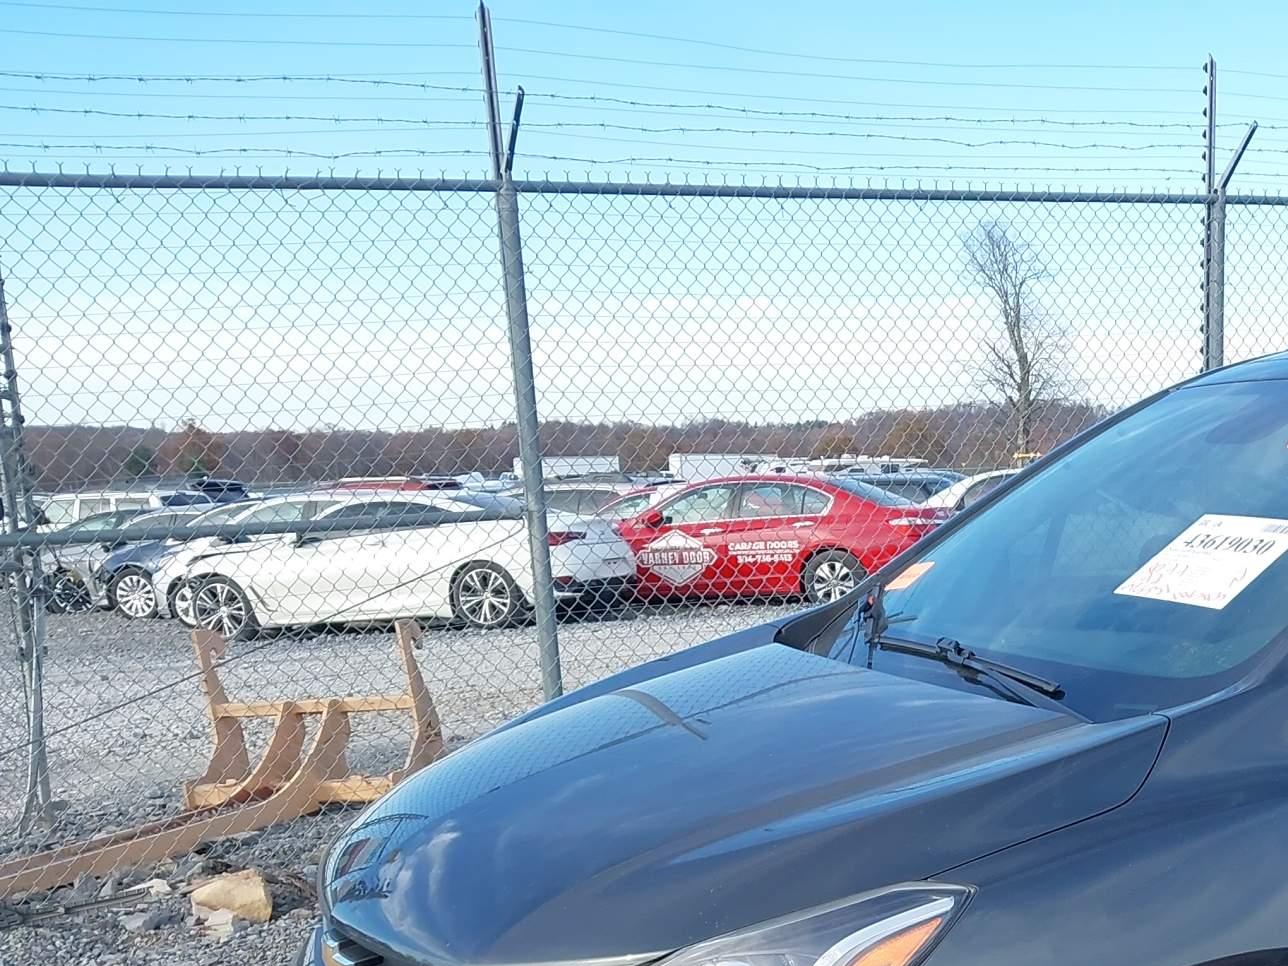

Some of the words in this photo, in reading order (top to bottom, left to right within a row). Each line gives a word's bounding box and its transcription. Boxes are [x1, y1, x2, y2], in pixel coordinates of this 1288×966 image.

[766, 540, 799, 549] DOORS
[1183, 532, 1276, 556] 43619030
[641, 551, 680, 564] VARNEY
[682, 551, 710, 564] DOOR
